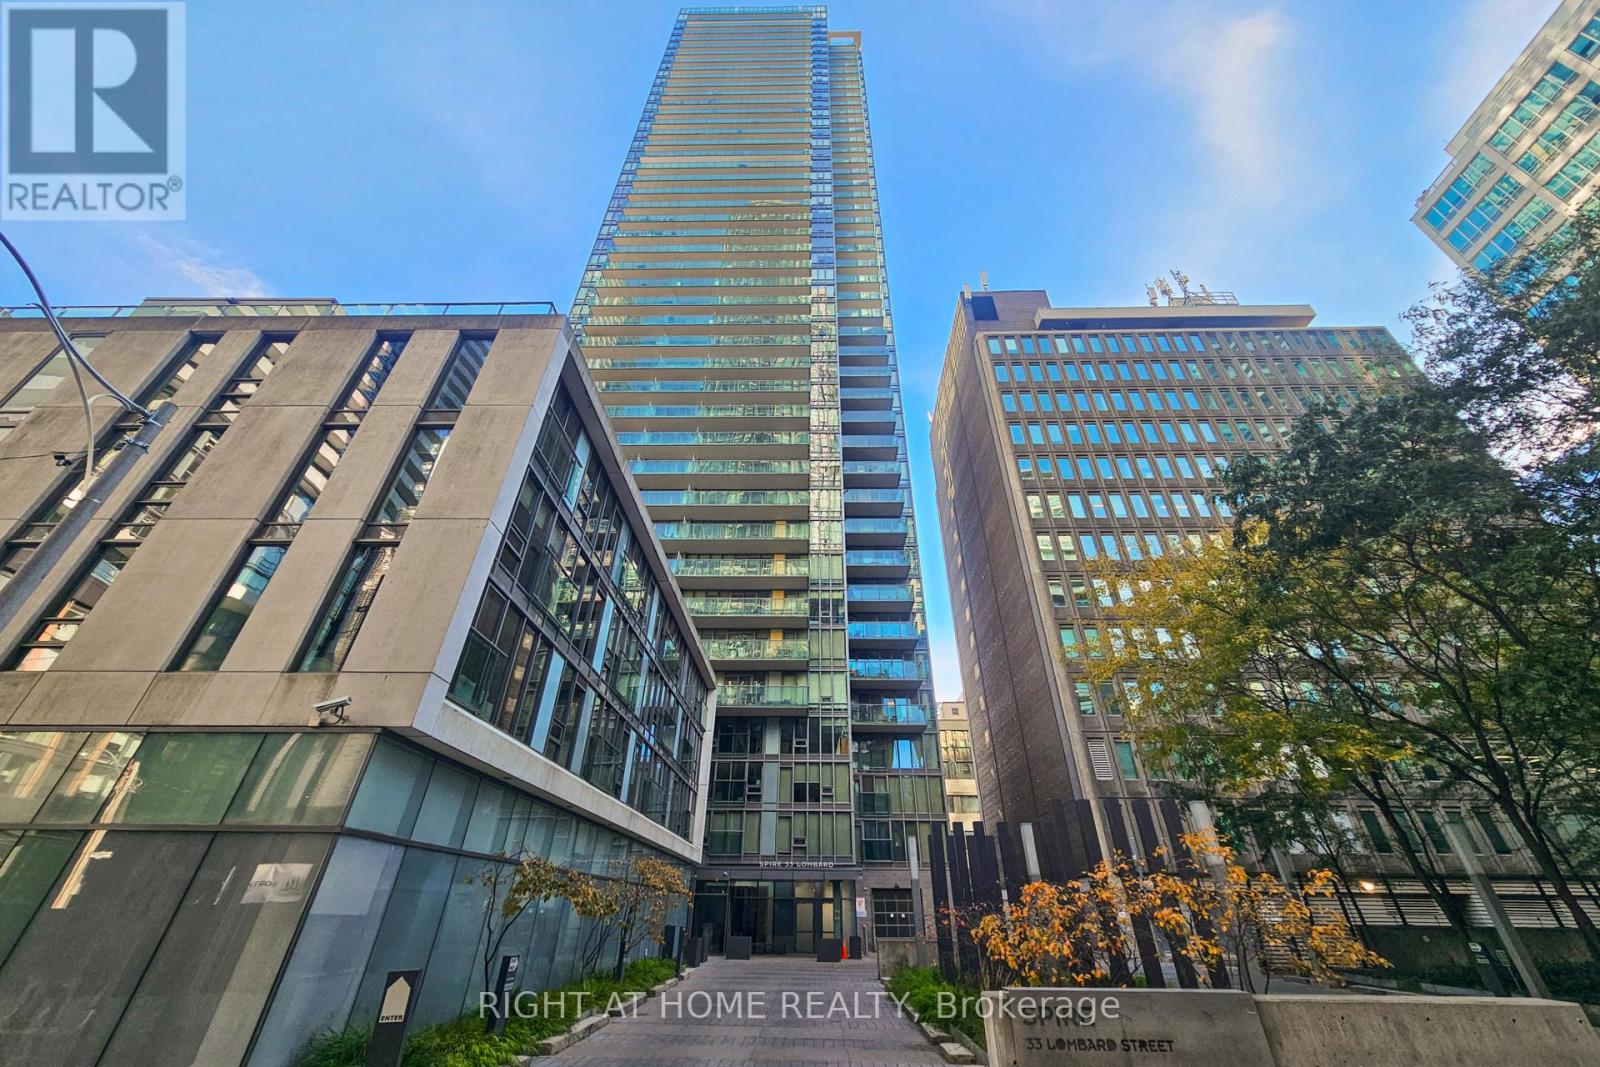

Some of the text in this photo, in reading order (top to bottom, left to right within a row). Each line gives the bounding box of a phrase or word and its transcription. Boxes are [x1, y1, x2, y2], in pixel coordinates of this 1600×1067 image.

[1026, 1037, 1174, 1053] 33 LOMBARD STREET
